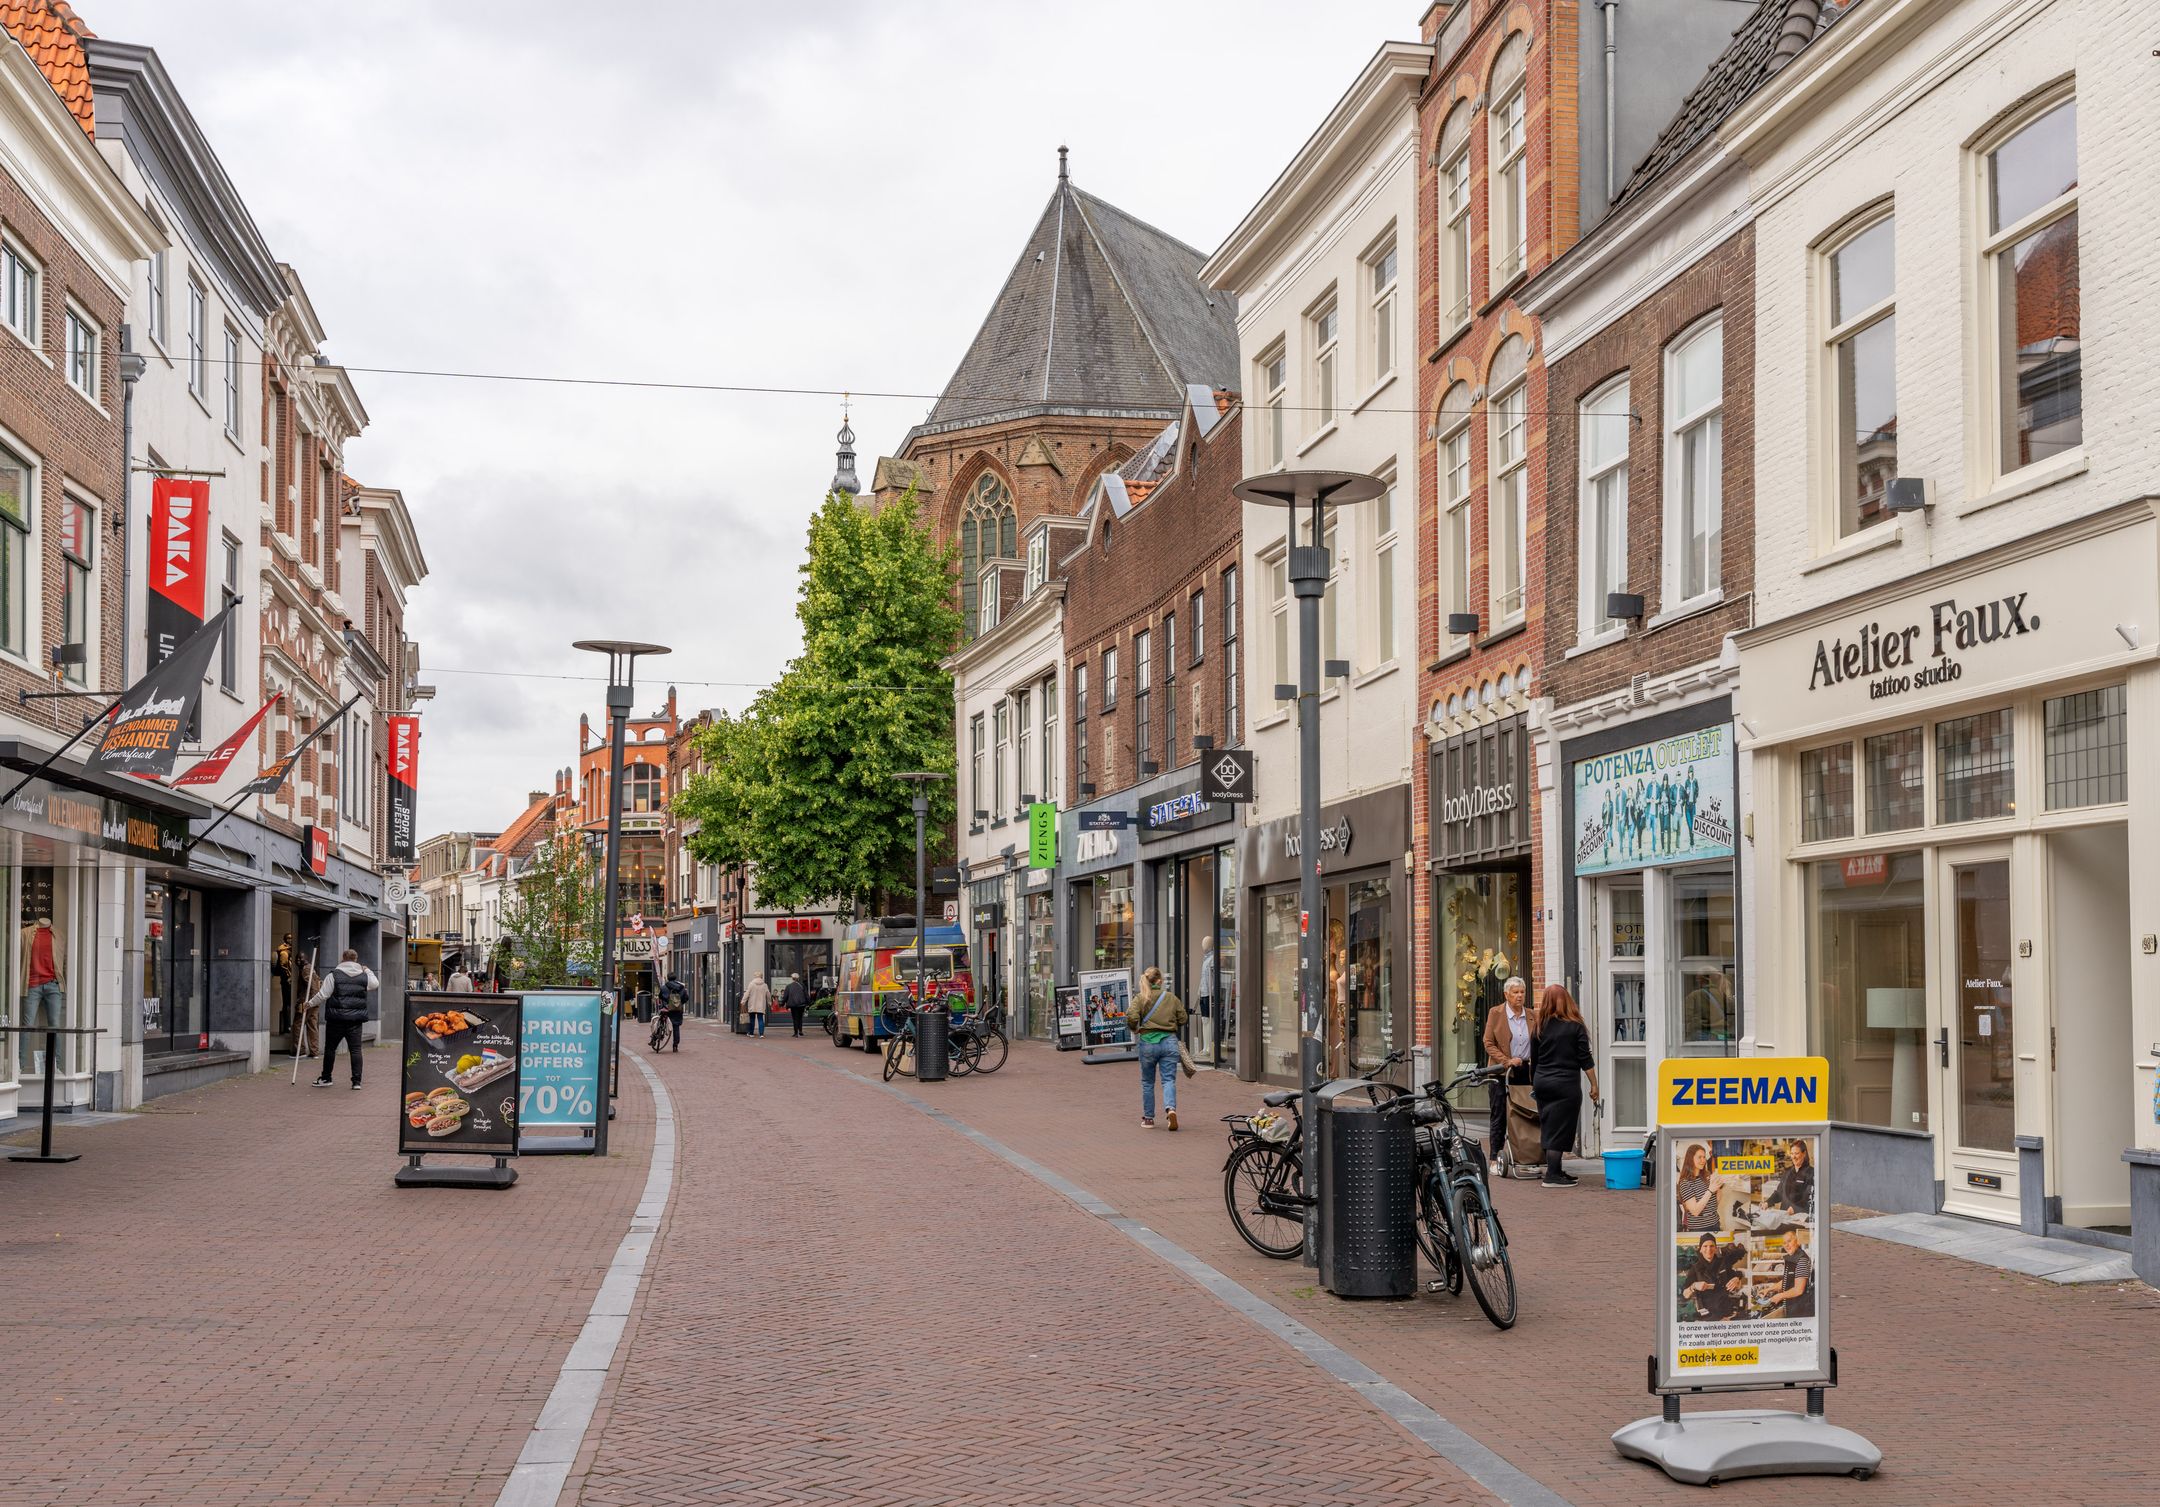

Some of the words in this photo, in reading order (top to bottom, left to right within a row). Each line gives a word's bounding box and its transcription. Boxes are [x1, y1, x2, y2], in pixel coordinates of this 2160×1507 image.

[166, 496, 192, 587] DAKA
[1808, 622, 1920, 690] Atelier
[1930, 592, 2041, 657] Faux.
[1869, 675, 1911, 700] tattoo
[1914, 656, 1962, 689] studio
[108, 718, 179, 739] VOLENDAMMER
[101, 732, 170, 754] VISHANDEL
[396, 724, 411, 773] DAKA
[1584, 747, 1655, 786] POTENZA
[1656, 728, 1722, 769] OUTLET
[1212, 791, 1244, 799] bodyDress
[1444, 783, 1512, 828] bodyDress
[48, 795, 101, 837] VOLENDAMMER
[127, 817, 160, 851] VISHANDEL
[394, 798, 402, 848] LIFESTYLE
[402, 807, 410, 836] SPORT
[1149, 797, 1181, 828] STATE
[1038, 811, 1048, 861] ZIENGS
[1694, 819, 1732, 845] DISCOUNT
[1577, 830, 1606, 864] DISCOUNT
[776, 918, 822, 934] FEBO
[1965, 979, 1986, 988] Atelier
[1986, 979, 2004, 988] Faux.
[522, 1042, 586, 1054] SPECIAL
[522, 1057, 583, 1068] OFFERS
[520, 1085, 593, 1115] 70%
[1672, 1077, 1816, 1105] ZEEMAN
[1721, 1160, 1770, 1171] ZEEMAN
[1711, 1331, 1748, 1339] terugkomen
[1781, 1328, 1813, 1336] producten.
[1768, 1336, 1797, 1344] mogelijke
[1680, 1353, 1717, 1363] Ontdek
[1720, 1354, 1732, 1362] ze
[1735, 1351, 1757, 1361] ook.
